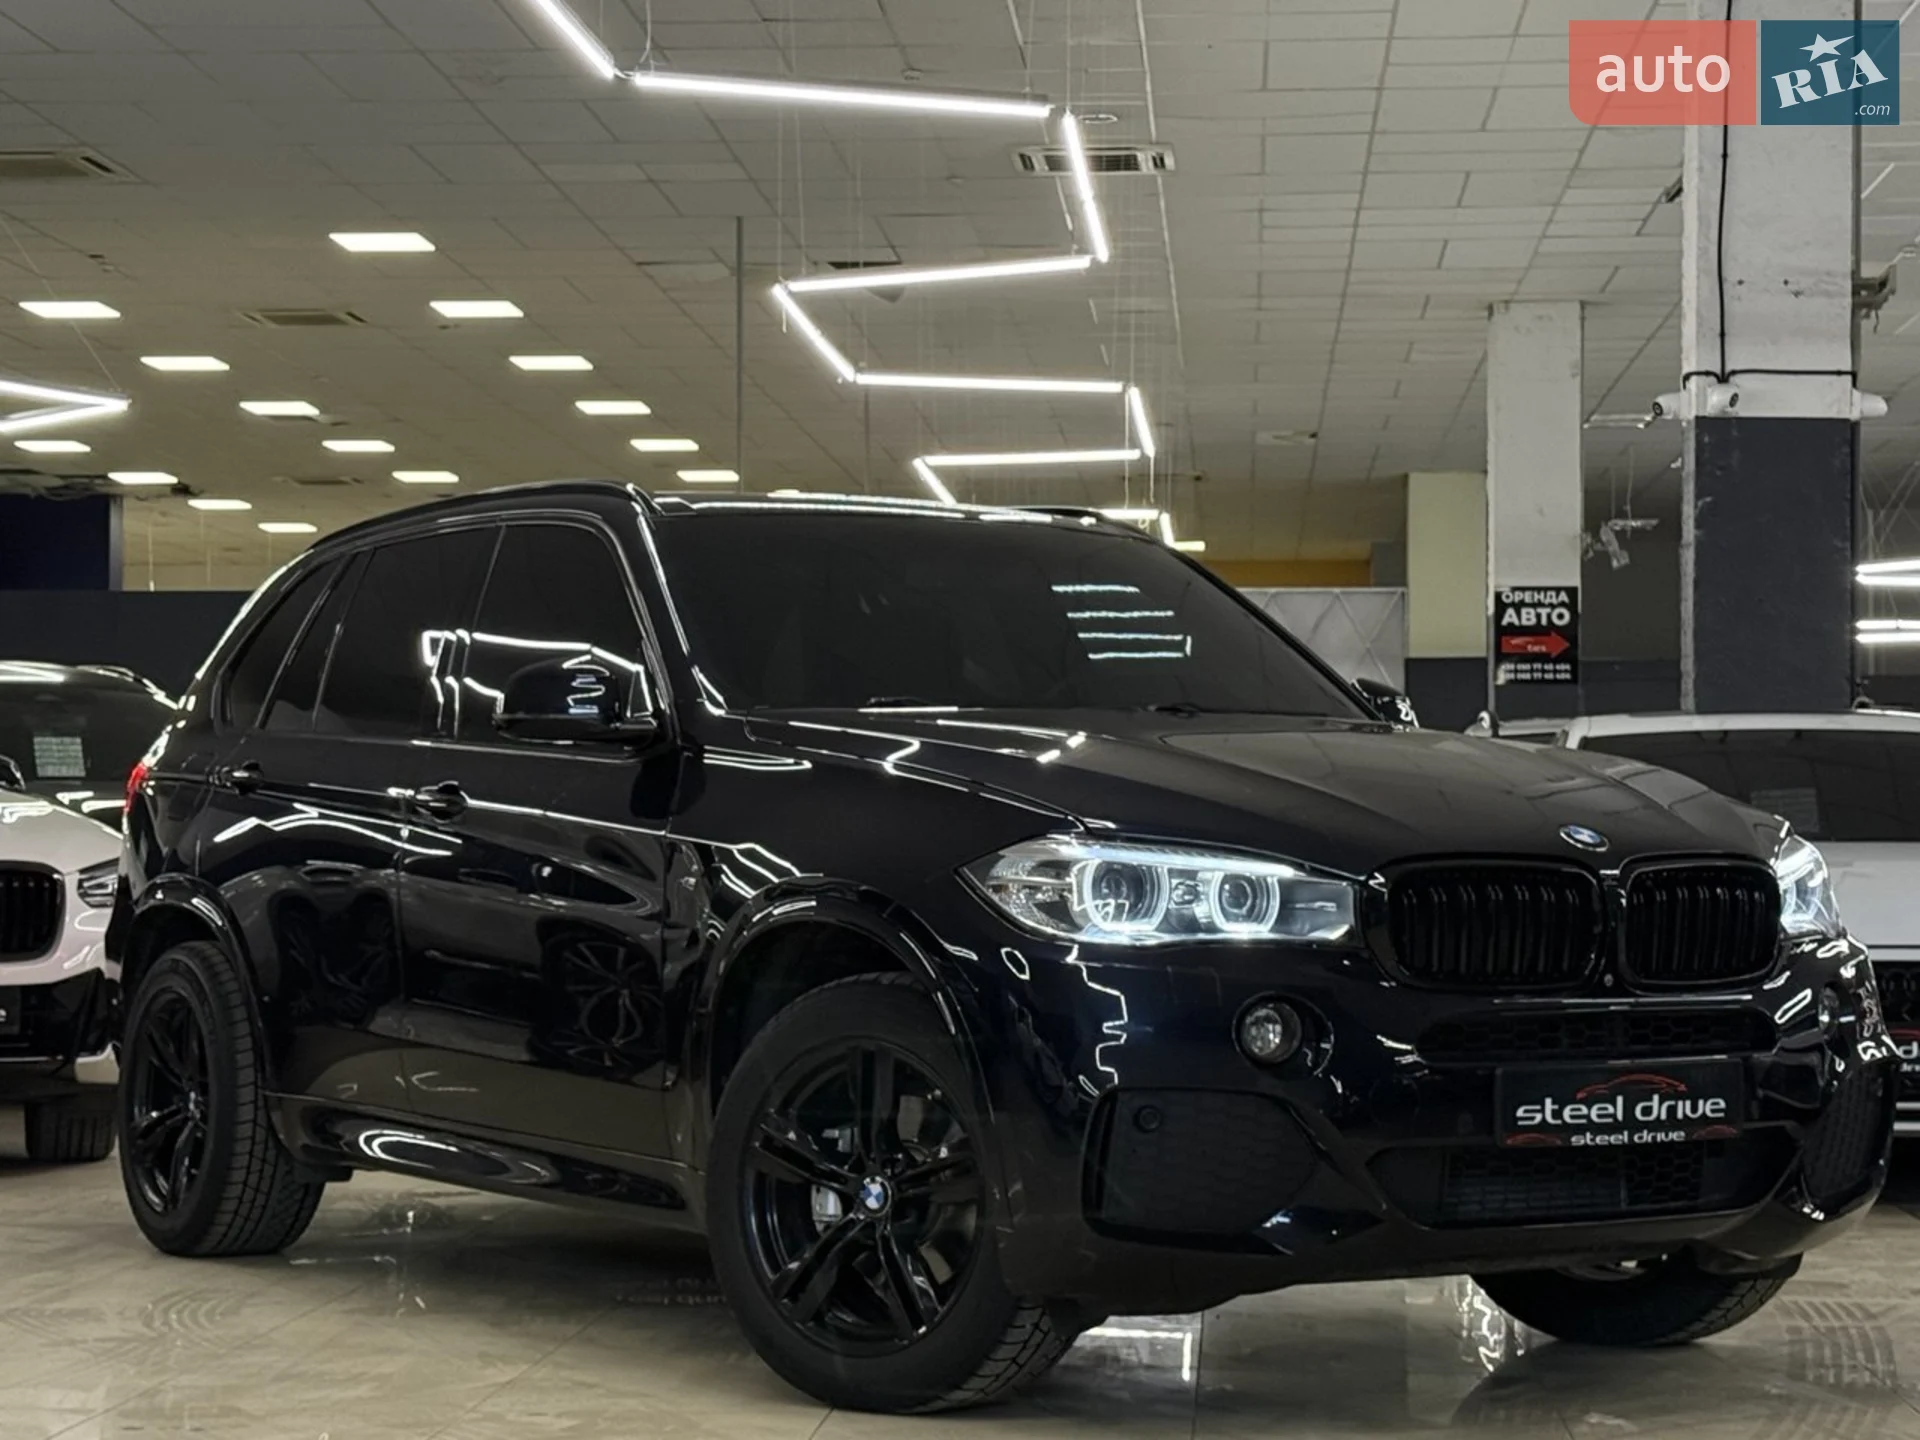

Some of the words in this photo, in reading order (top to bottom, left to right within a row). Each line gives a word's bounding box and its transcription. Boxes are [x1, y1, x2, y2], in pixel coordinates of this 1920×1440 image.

[1501, 590, 1570, 605] ОРЕНДА
[1501, 607, 1571, 626] АВТО
[1515, 1095, 1623, 1125] steel
[1634, 1094, 1727, 1121] drive
[1570, 1130, 1629, 1146] steel
[1633, 1129, 1686, 1143] drive
